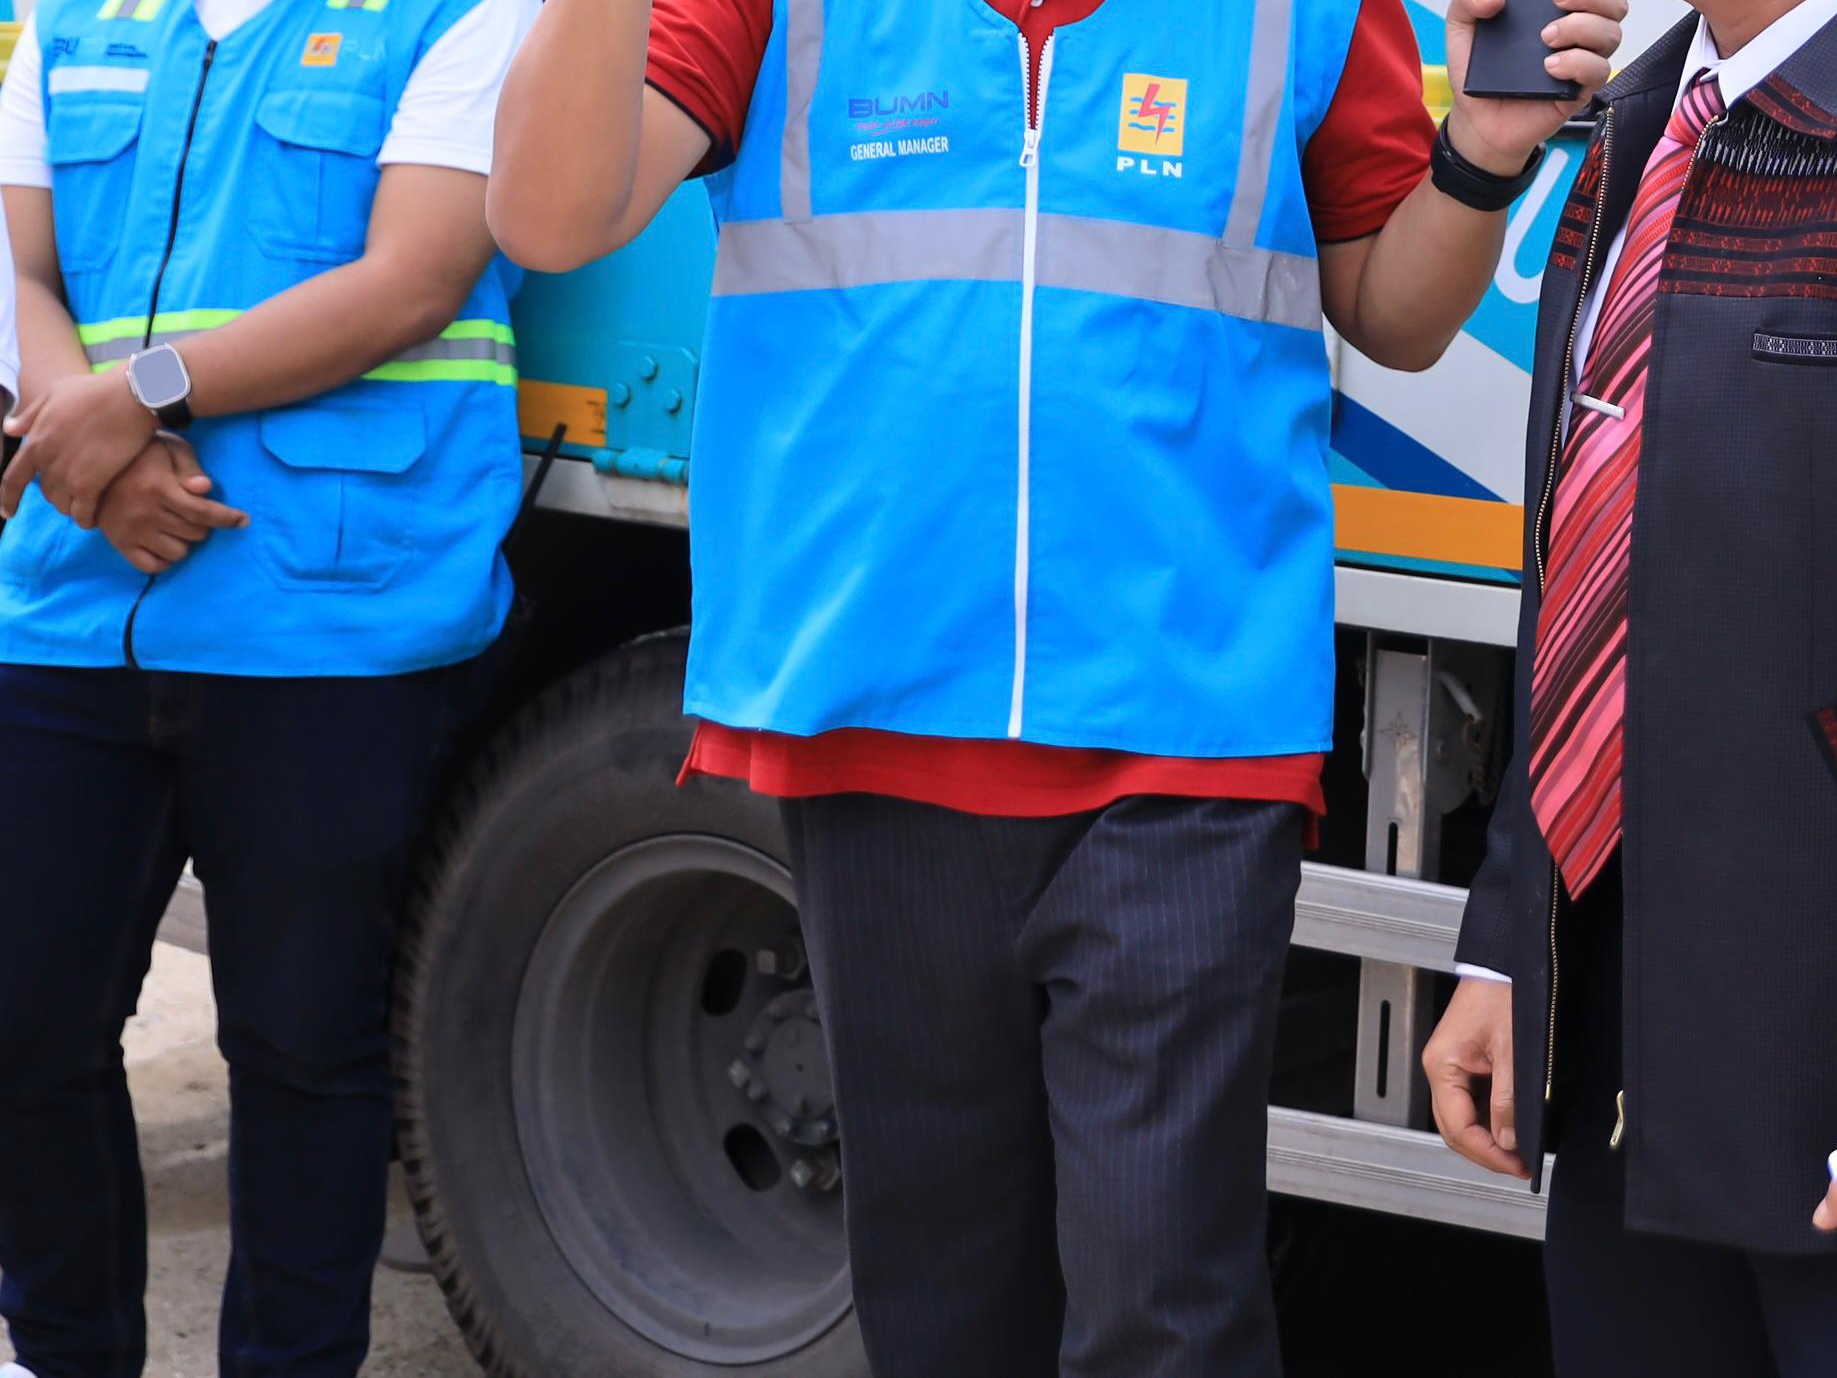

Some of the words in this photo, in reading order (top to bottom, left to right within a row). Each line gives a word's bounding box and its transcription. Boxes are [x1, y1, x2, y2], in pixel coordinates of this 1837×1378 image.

[848, 89, 949, 119] BUMN
[850, 141, 896, 161] GENERAL
[897, 136, 949, 156] MANAGER
[1116, 155, 1183, 179] PLN
